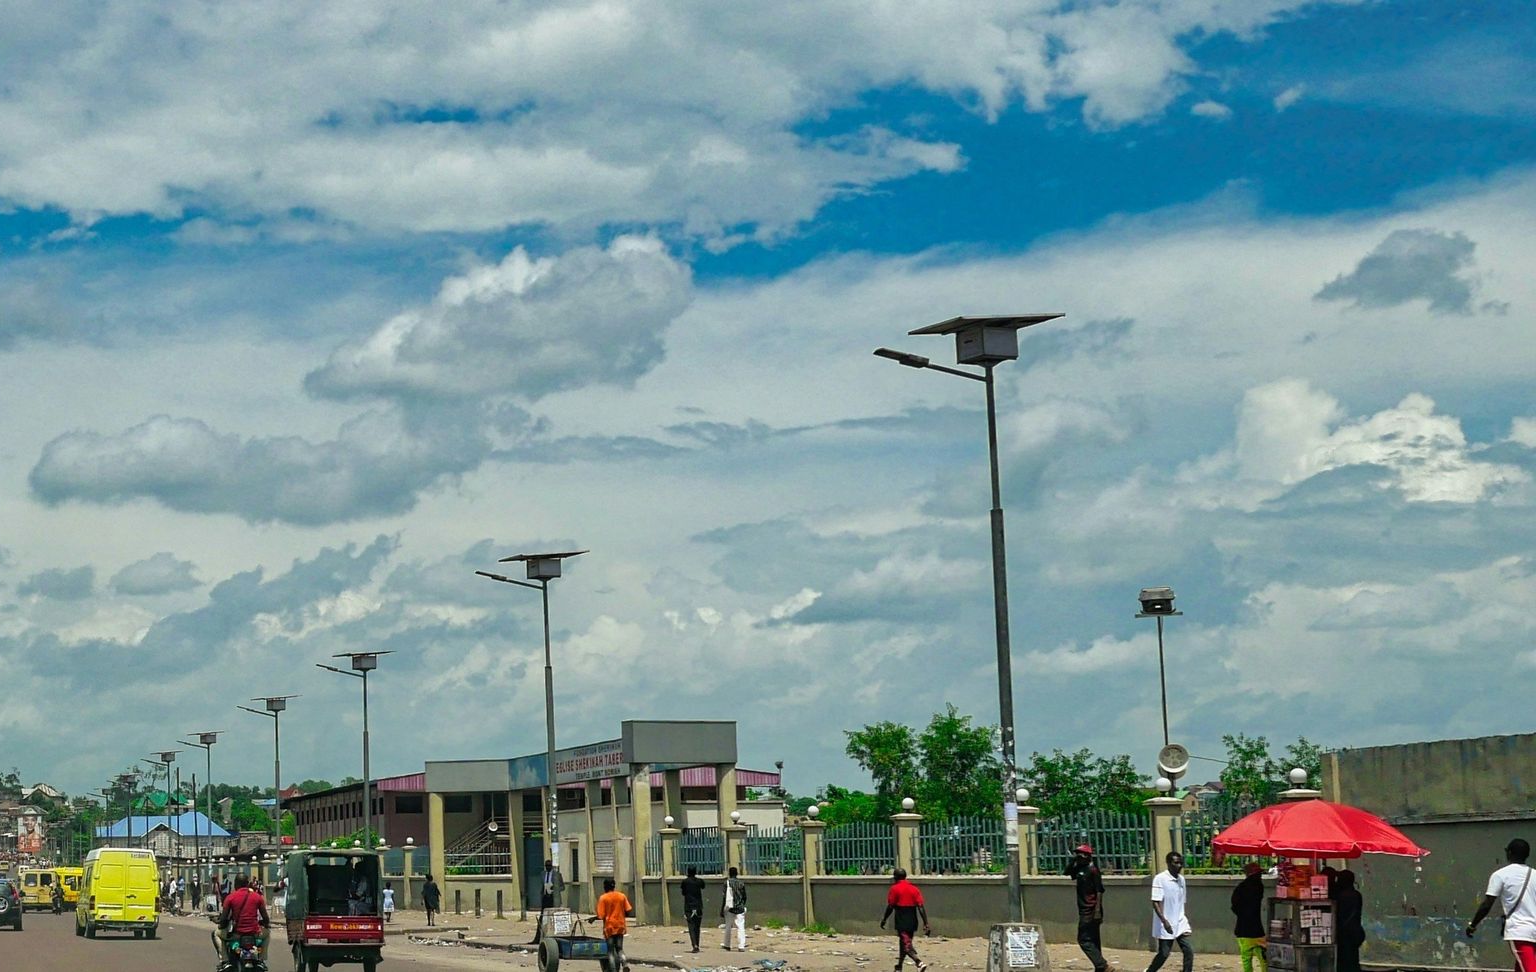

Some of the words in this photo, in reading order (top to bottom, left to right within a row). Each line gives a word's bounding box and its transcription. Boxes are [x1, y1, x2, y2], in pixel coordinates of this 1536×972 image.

[556, 760, 574, 773] EGLISE
[575, 755, 603, 771] SHEKINAH
[576, 771, 591, 779] TEMPLE
